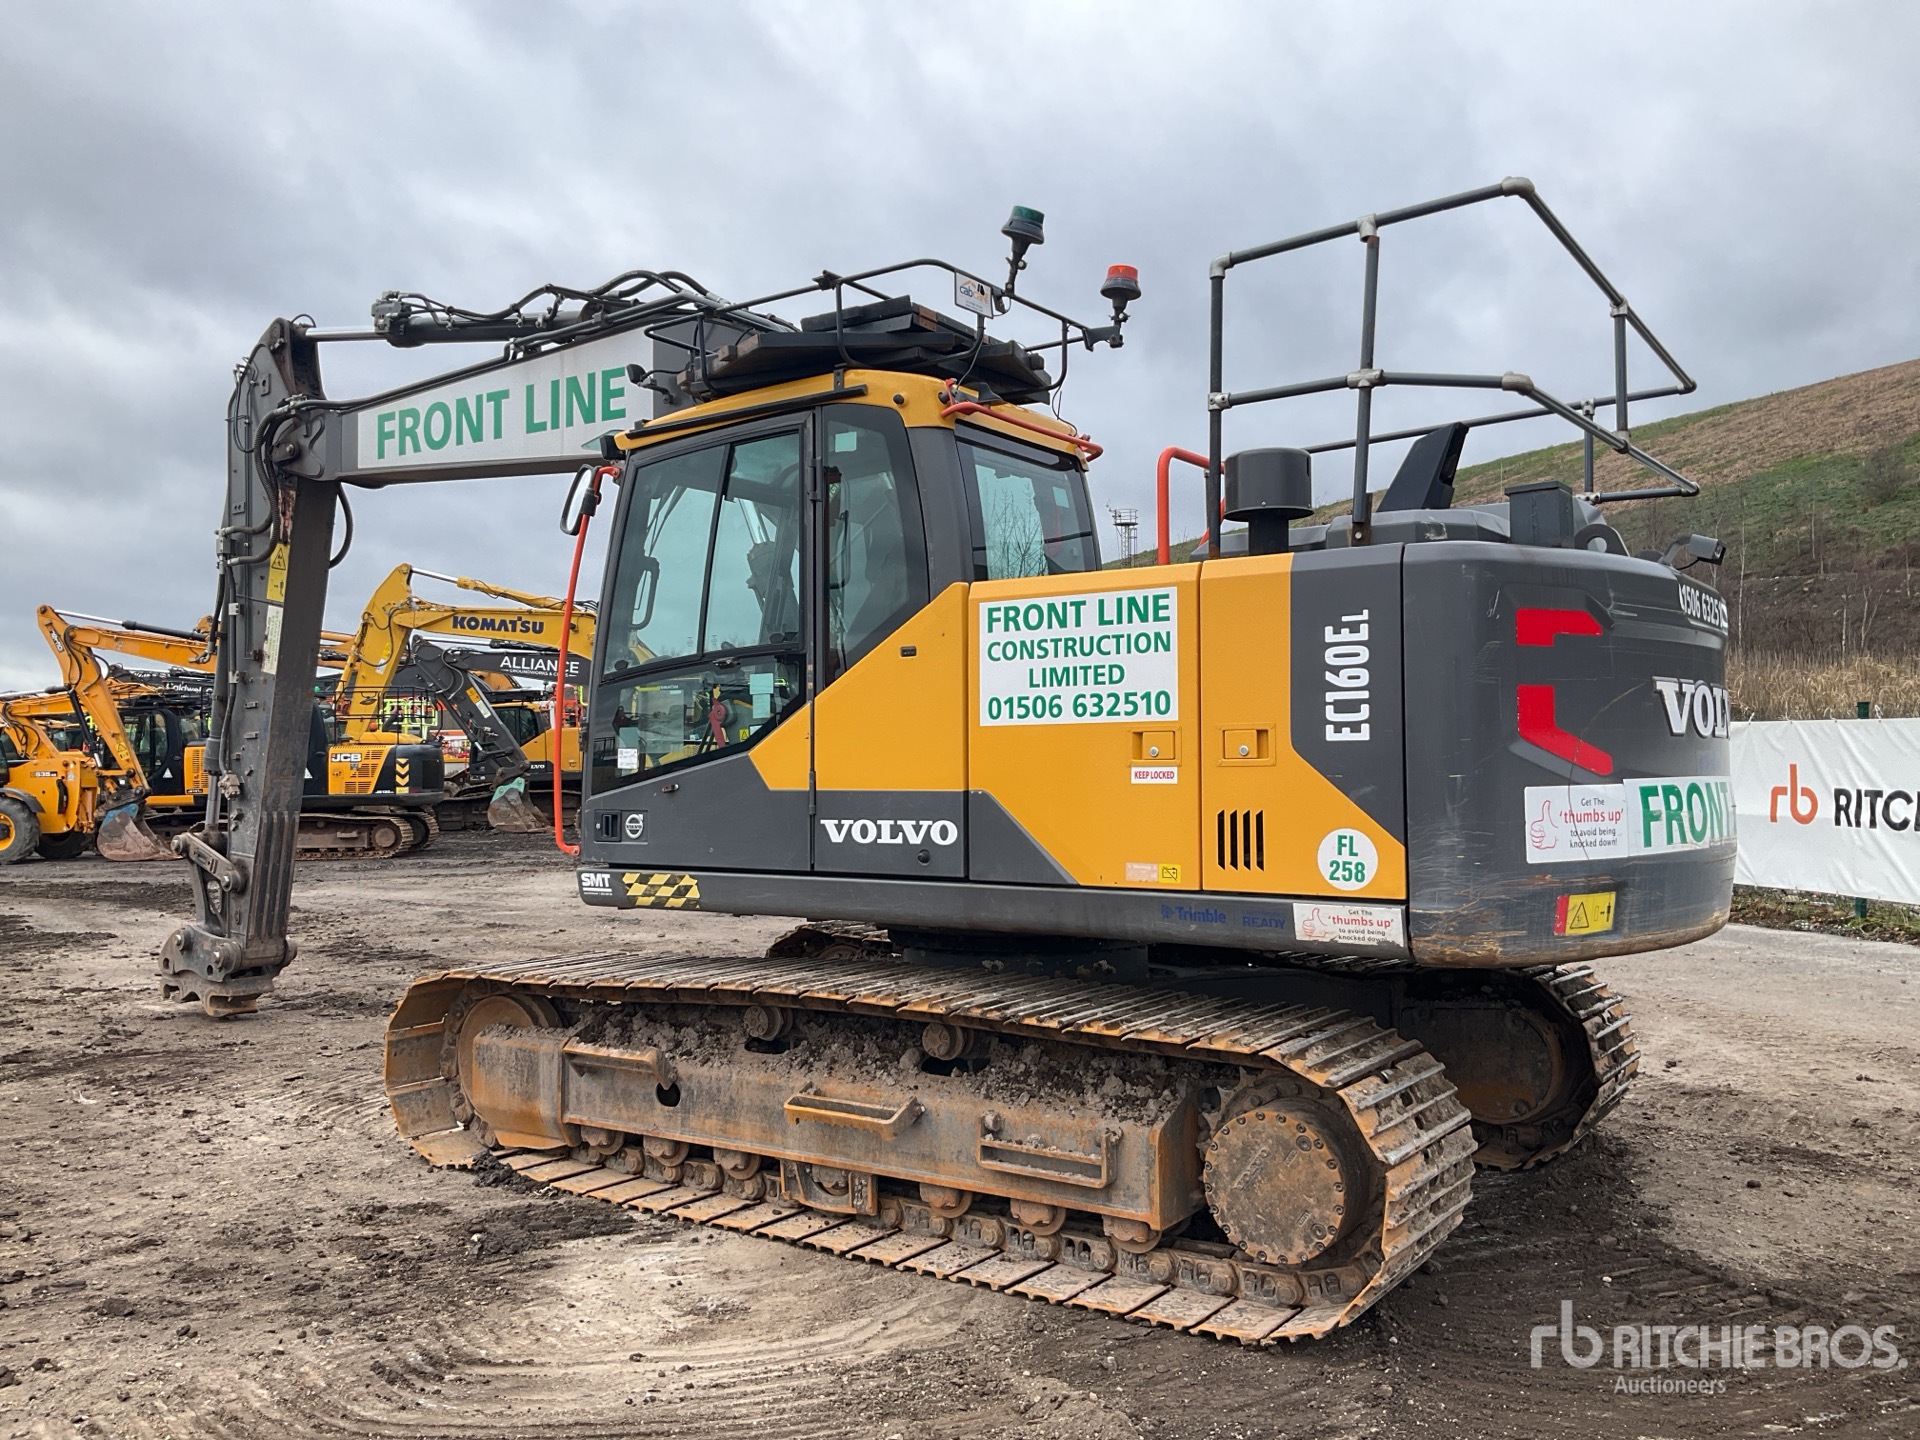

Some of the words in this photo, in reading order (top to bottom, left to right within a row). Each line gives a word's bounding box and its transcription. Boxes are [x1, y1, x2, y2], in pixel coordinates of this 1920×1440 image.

[377, 389, 510, 460] FRONT
[525, 366, 626, 434] LINE
[987, 600, 1086, 634] FRONT
[1098, 593, 1171, 626] LINE
[452, 616, 545, 634] KOMATSU
[987, 631, 1171, 662] CONSTRUCTION
[1029, 664, 1125, 689] LIMITED
[988, 694, 1063, 720] 01506
[1072, 690, 1171, 718] 632510
[1653, 676, 1730, 739] VOL
[331, 753, 362, 762] JCB
[1134, 770, 1150, 780] KEEP
[1150, 770, 1175, 780] LOCKED
[1581, 797, 1592, 806] Get
[1593, 797, 1605, 806] The
[1834, 788, 1920, 832] RITC
[820, 819, 958, 846] VOLVO
[1570, 829, 1578, 837] to
[1579, 827, 1597, 837] avoid
[1598, 826, 1616, 837] being
[1337, 835, 1358, 857] FL
[1570, 838, 1597, 848] knocked
[1598, 838, 1618, 847] down!
[581, 873, 611, 887] SMT
[1329, 859, 1366, 883] 258
[1175, 906, 1227, 924] Trimble
[1242, 916, 1286, 929] READY
